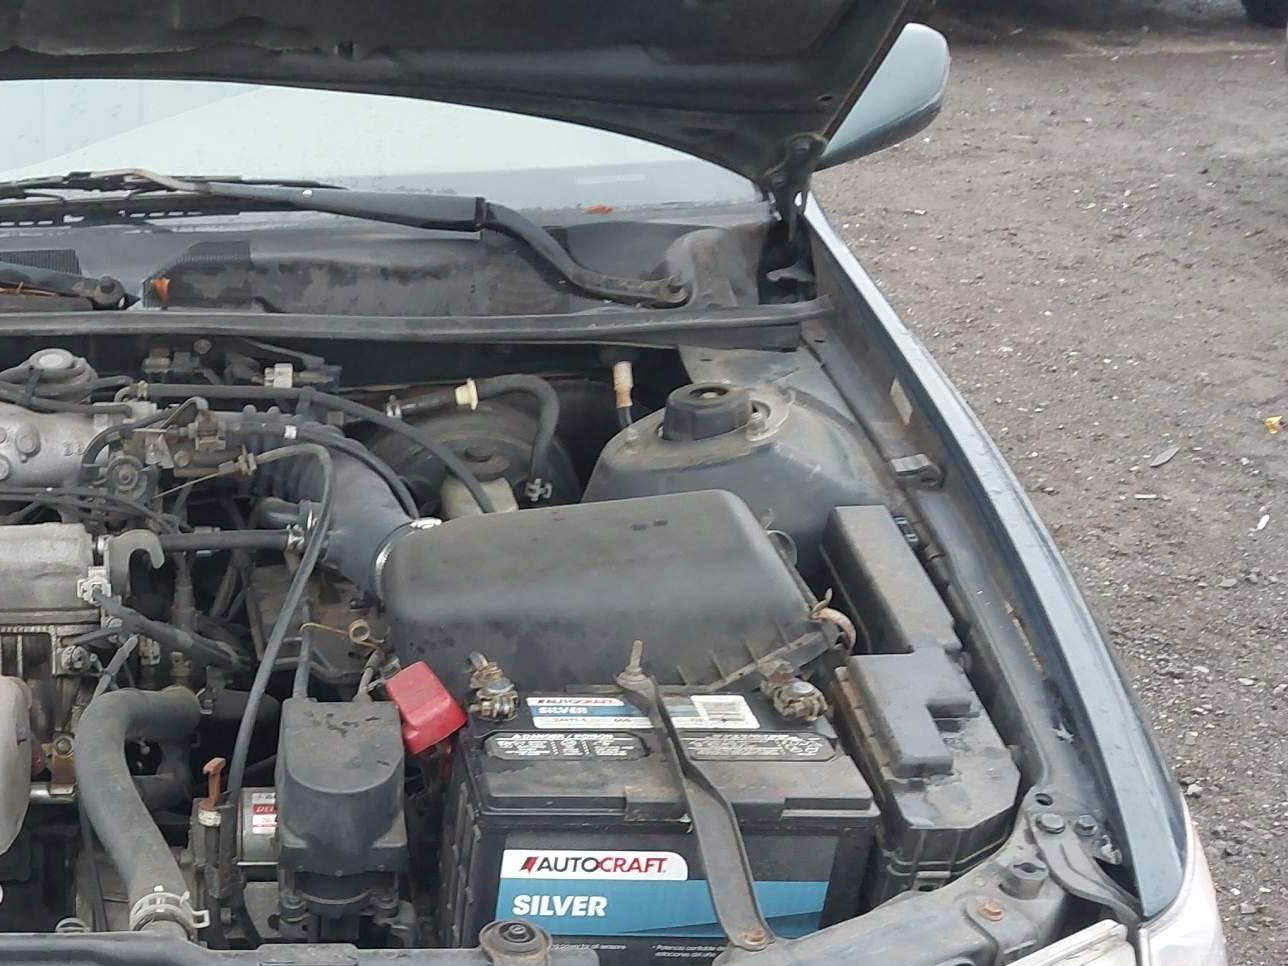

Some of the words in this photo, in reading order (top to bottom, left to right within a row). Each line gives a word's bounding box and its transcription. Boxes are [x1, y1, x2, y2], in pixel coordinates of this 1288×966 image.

[538, 706, 588, 715] SILVER
[536, 856, 668, 873] AUTOCRAFT
[512, 894, 608, 917] SILVER
